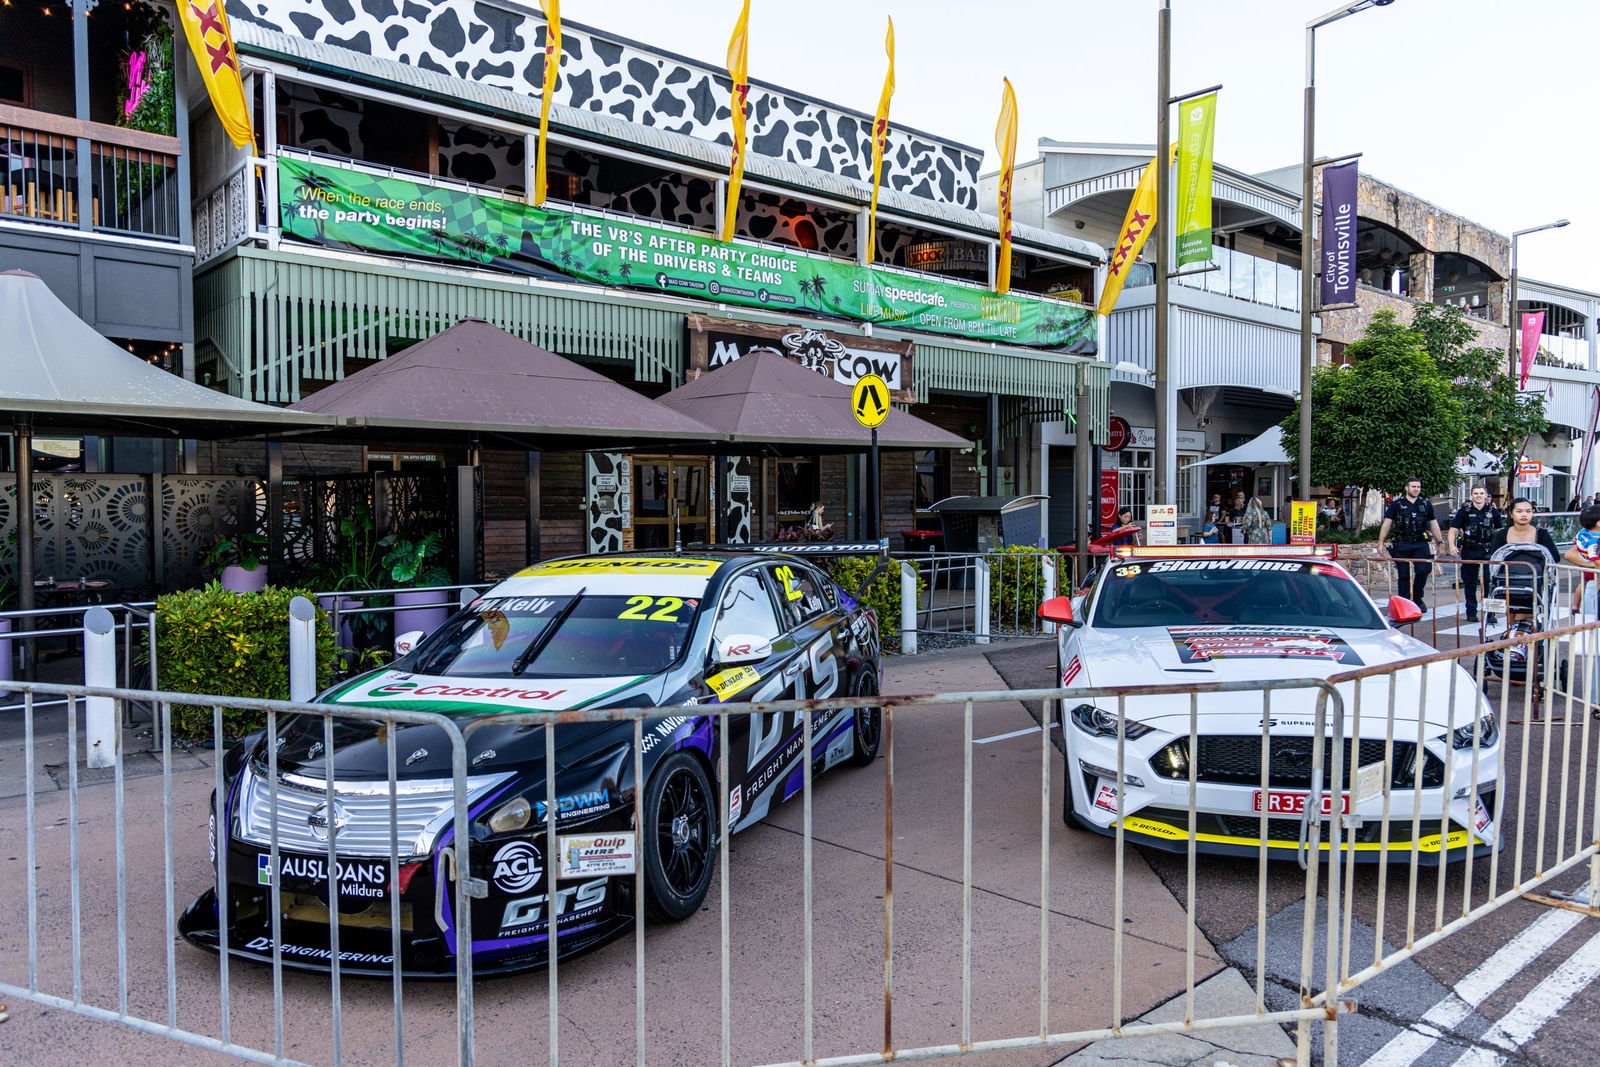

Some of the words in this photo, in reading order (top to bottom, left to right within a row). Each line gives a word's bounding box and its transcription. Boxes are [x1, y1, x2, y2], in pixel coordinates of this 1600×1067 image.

[301, 187, 344, 202] When
[348, 193, 371, 206] the
[376, 197, 405, 209] race
[409, 200, 445, 214] ends,
[299, 205, 329, 219] the
[335, 210, 380, 225] party
[385, 213, 447, 230] begins!
[571, 220, 602, 238] THE
[608, 227, 642, 245] V8'S
[649, 235, 696, 254] AFTER
[701, 244, 747, 263] PARTY
[751, 254, 797, 272] CHOICE
[953, 248, 988, 262] BAR
[1109, 209, 1151, 277] XXXX
[1335, 204, 1351, 294] Townsville
[592, 241, 612, 256] OF
[618, 246, 648, 263] THE
[654, 252, 716, 274] DRIVERS
[722, 264, 731, 277] &
[737, 266, 782, 285] TEAMS
[1326, 251, 1335, 261] of
[1326, 263, 1337, 283] City
[853, 280, 885, 297] SUNDAY
[885, 285, 948, 308] speedcafe.
[860, 302, 878, 317] LIVE
[879, 306, 907, 321] MUSIC
[919, 313, 942, 328] OPEN
[944, 317, 966, 331] FROM
[968, 320, 985, 334] 8PM
[986, 323, 998, 335] TIL
[999, 325, 1017, 339] LATE
[837, 353, 897, 384] COW
[552, 560, 709, 569] DUNLOP
[1116, 565, 1141, 577] 33
[617, 596, 684, 622] 22
[727, 644, 751, 656] KR
[413, 685, 568, 700] Castrol
[719, 672, 744, 690] DUNLOP
[746, 754, 784, 801] FREIGHT
[559, 788, 609, 812] DWM
[560, 803, 610, 819] ENGINEERING
[1138, 823, 1176, 835] DUNLOP
[492, 858, 543, 879] ACL
[341, 883, 384, 898] Mildura
[501, 875, 609, 928] GTS
[499, 925, 540, 937] FREIGHT
[544, 906, 603, 928] MNAGEMENT
